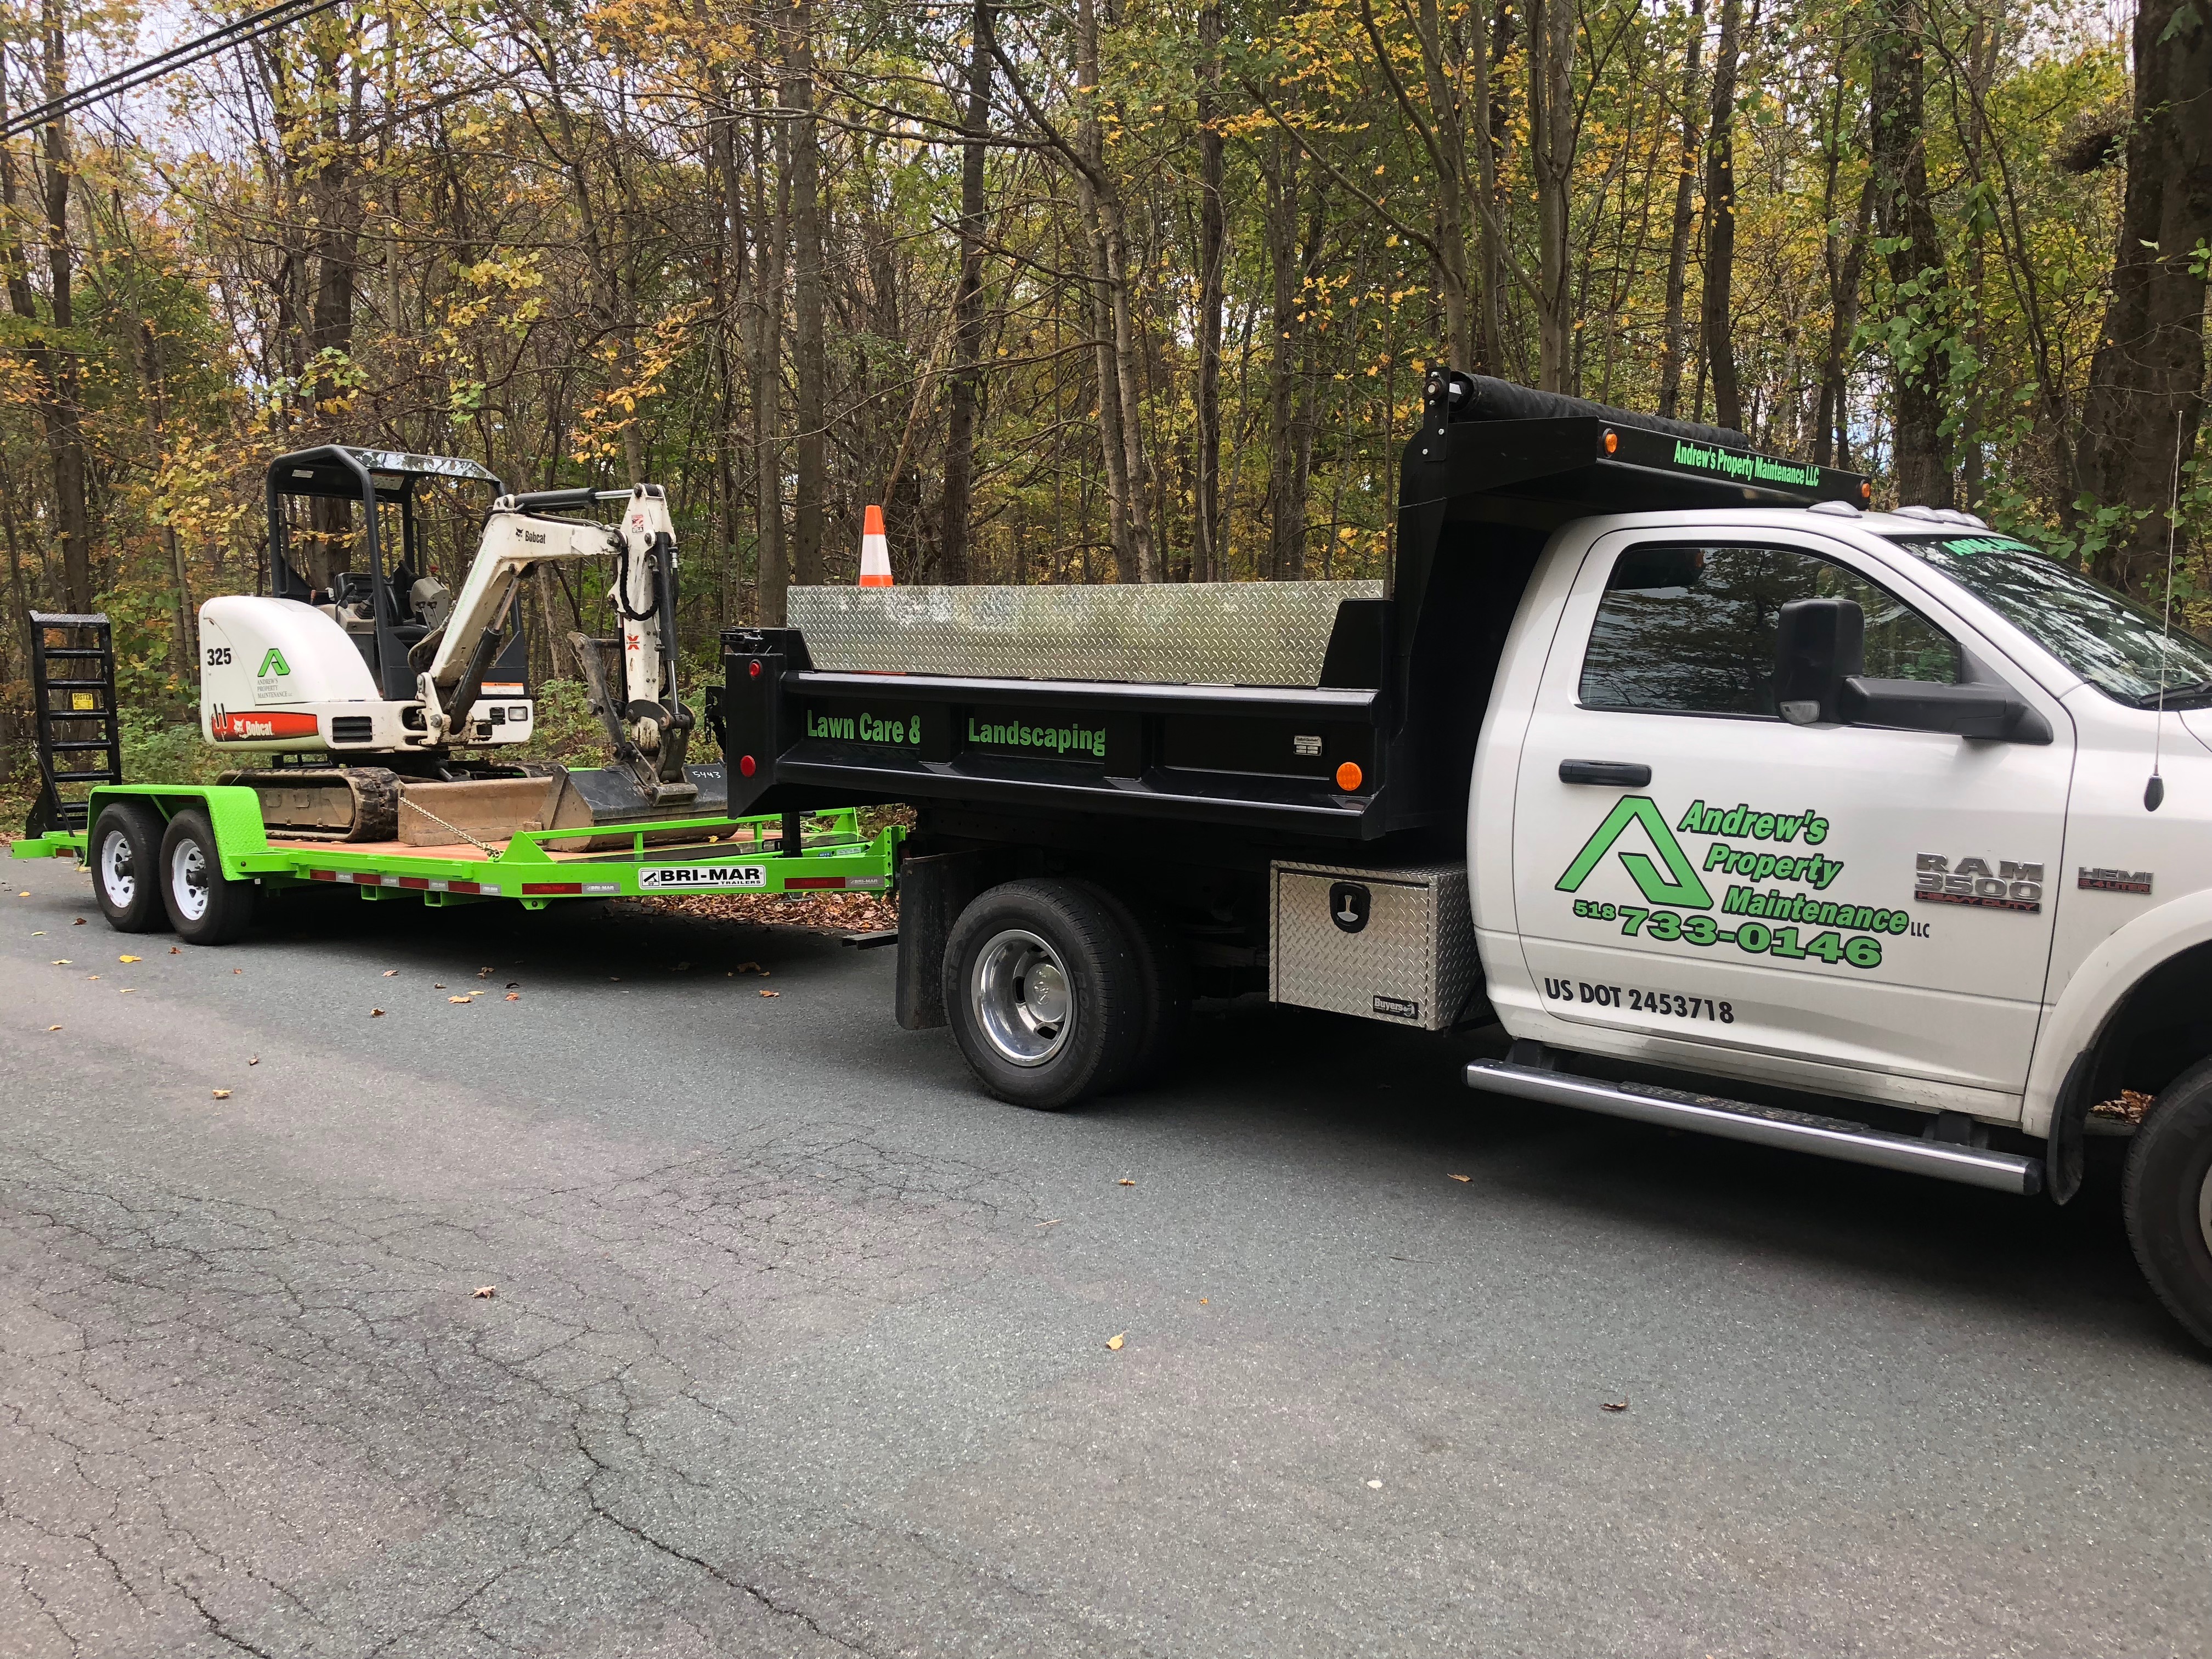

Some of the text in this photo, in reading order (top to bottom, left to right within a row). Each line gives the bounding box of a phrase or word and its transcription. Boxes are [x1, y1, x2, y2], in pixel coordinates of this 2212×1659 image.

[1673, 441, 1819, 487] Andrew's Property Maintenance LLC
[525, 531, 546, 544] Bobcat
[207, 648, 232, 666] 325
[246, 721, 273, 736] Bobcat
[808, 710, 1105, 757] Lawn Care & Landscaping
[1677, 799, 1829, 845] Andrew's
[661, 868, 760, 881] BRI-MAR
[1703, 843, 1844, 890] Property
[1916, 851, 2044, 881] RAM
[2078, 866, 2154, 884] HEMI
[1915, 871, 2042, 899] 3500
[2106, 881, 2149, 892] LITER
[1722, 886, 1930, 939] Maintenance LLC
[1918, 891, 2036, 910] HEAVY DUTY
[1573, 901, 1882, 968] 518 733-0146
[1374, 998, 1403, 1011] Buyers
[1544, 978, 1735, 1024] US DOT 2453718
